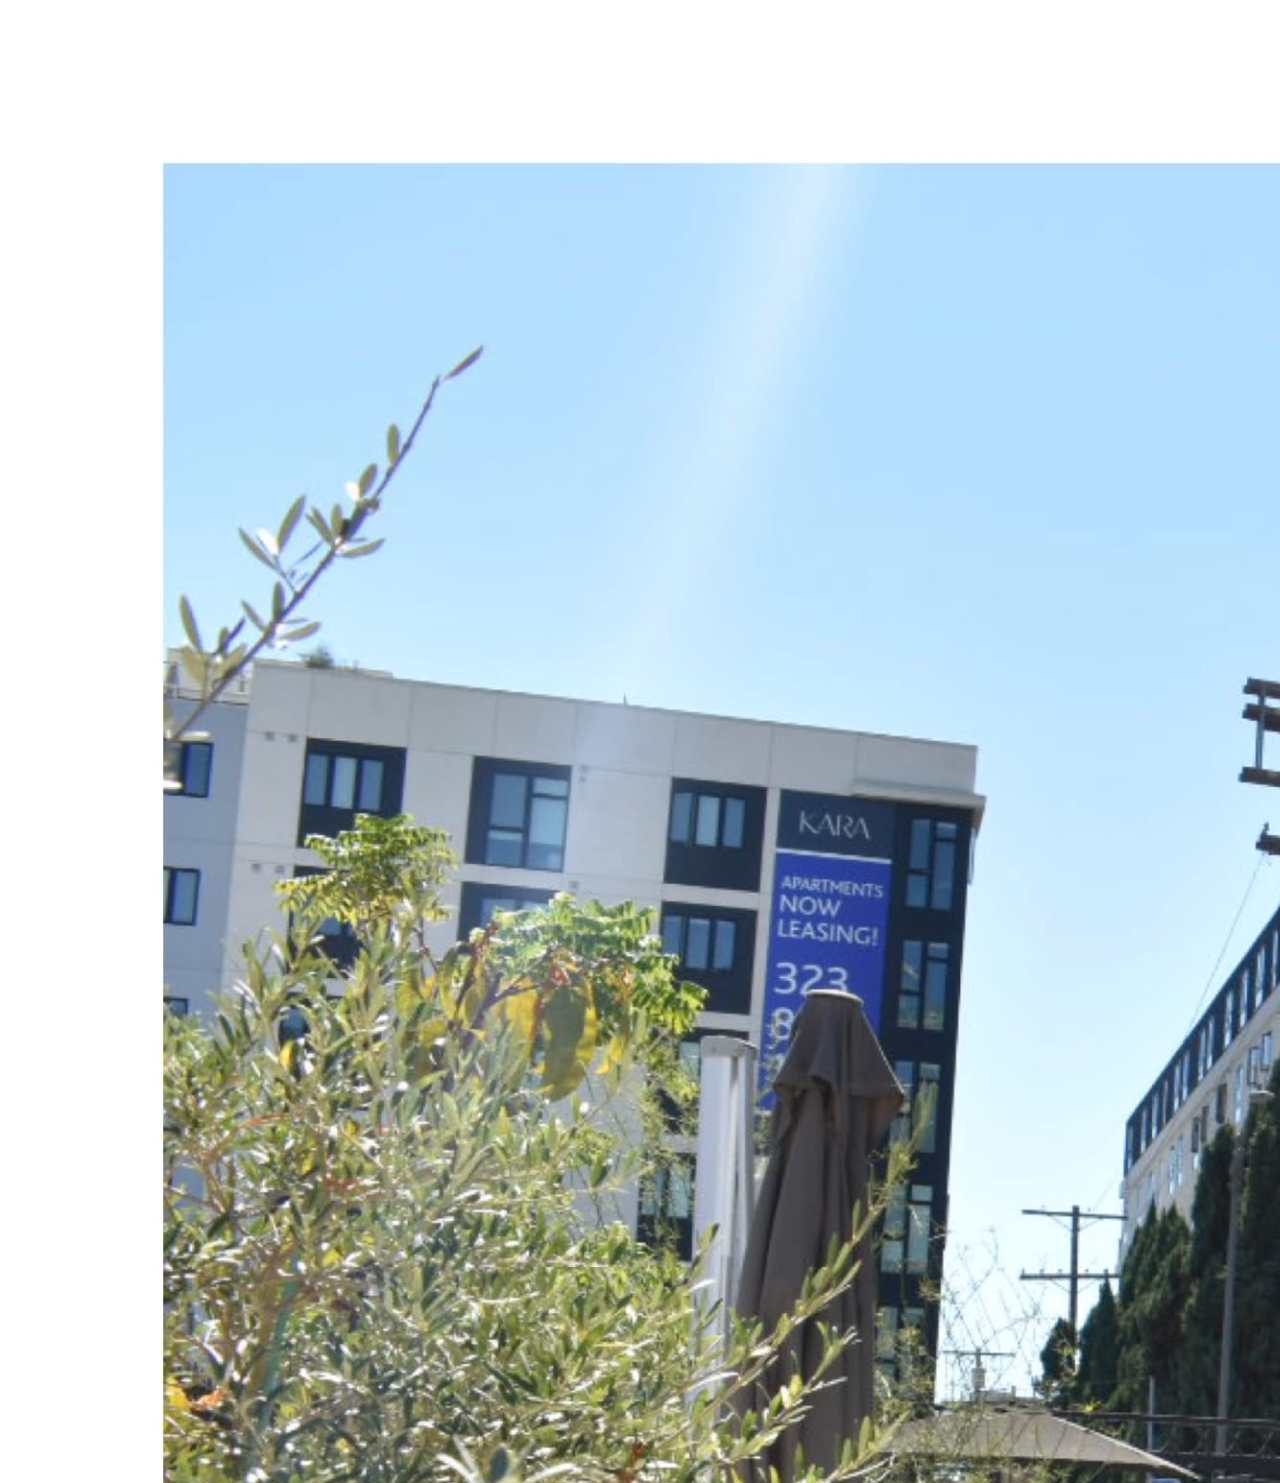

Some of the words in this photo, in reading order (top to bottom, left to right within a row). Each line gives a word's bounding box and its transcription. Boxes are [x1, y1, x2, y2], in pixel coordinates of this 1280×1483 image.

[799, 810, 871, 841] KARA
[781, 875, 884, 899] APARTMENTS
[779, 895, 842, 918] NOW
[776, 918, 880, 947] LEASING!
[773, 962, 849, 996] 323
